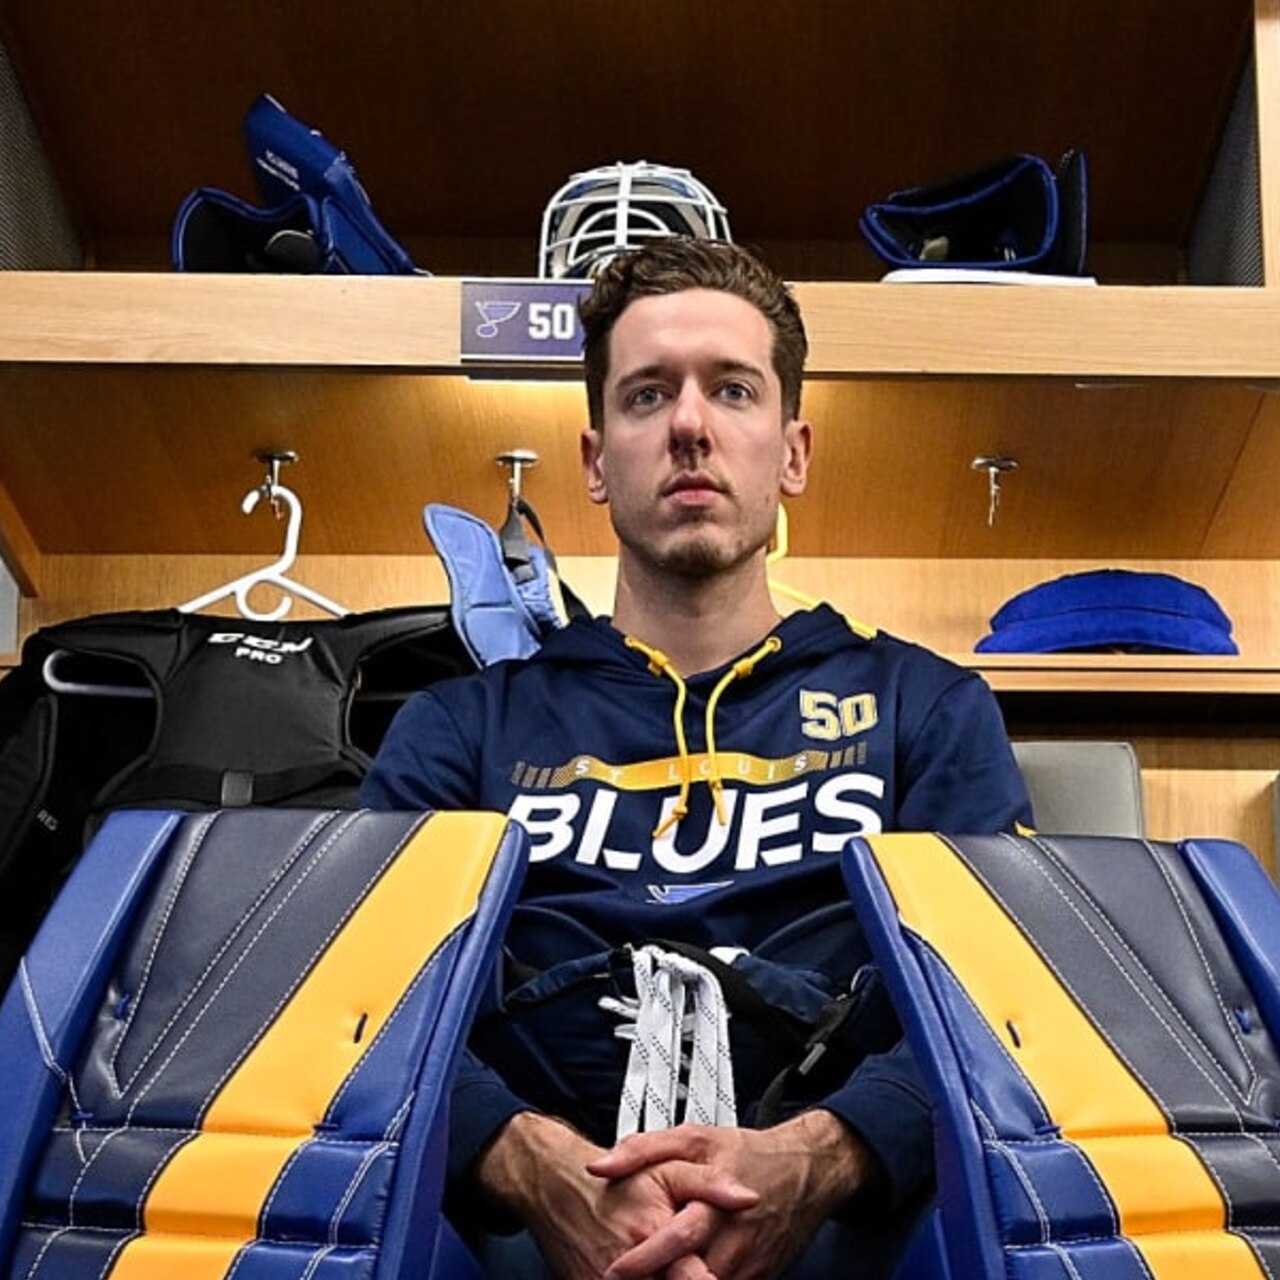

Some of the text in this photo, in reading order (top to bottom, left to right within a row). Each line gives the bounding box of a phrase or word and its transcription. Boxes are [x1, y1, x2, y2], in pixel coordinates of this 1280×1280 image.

[528, 302, 575, 340] 50
[235, 646, 283, 665] PRO
[799, 688, 879, 741] 50
[506, 773, 885, 874] BLUES
